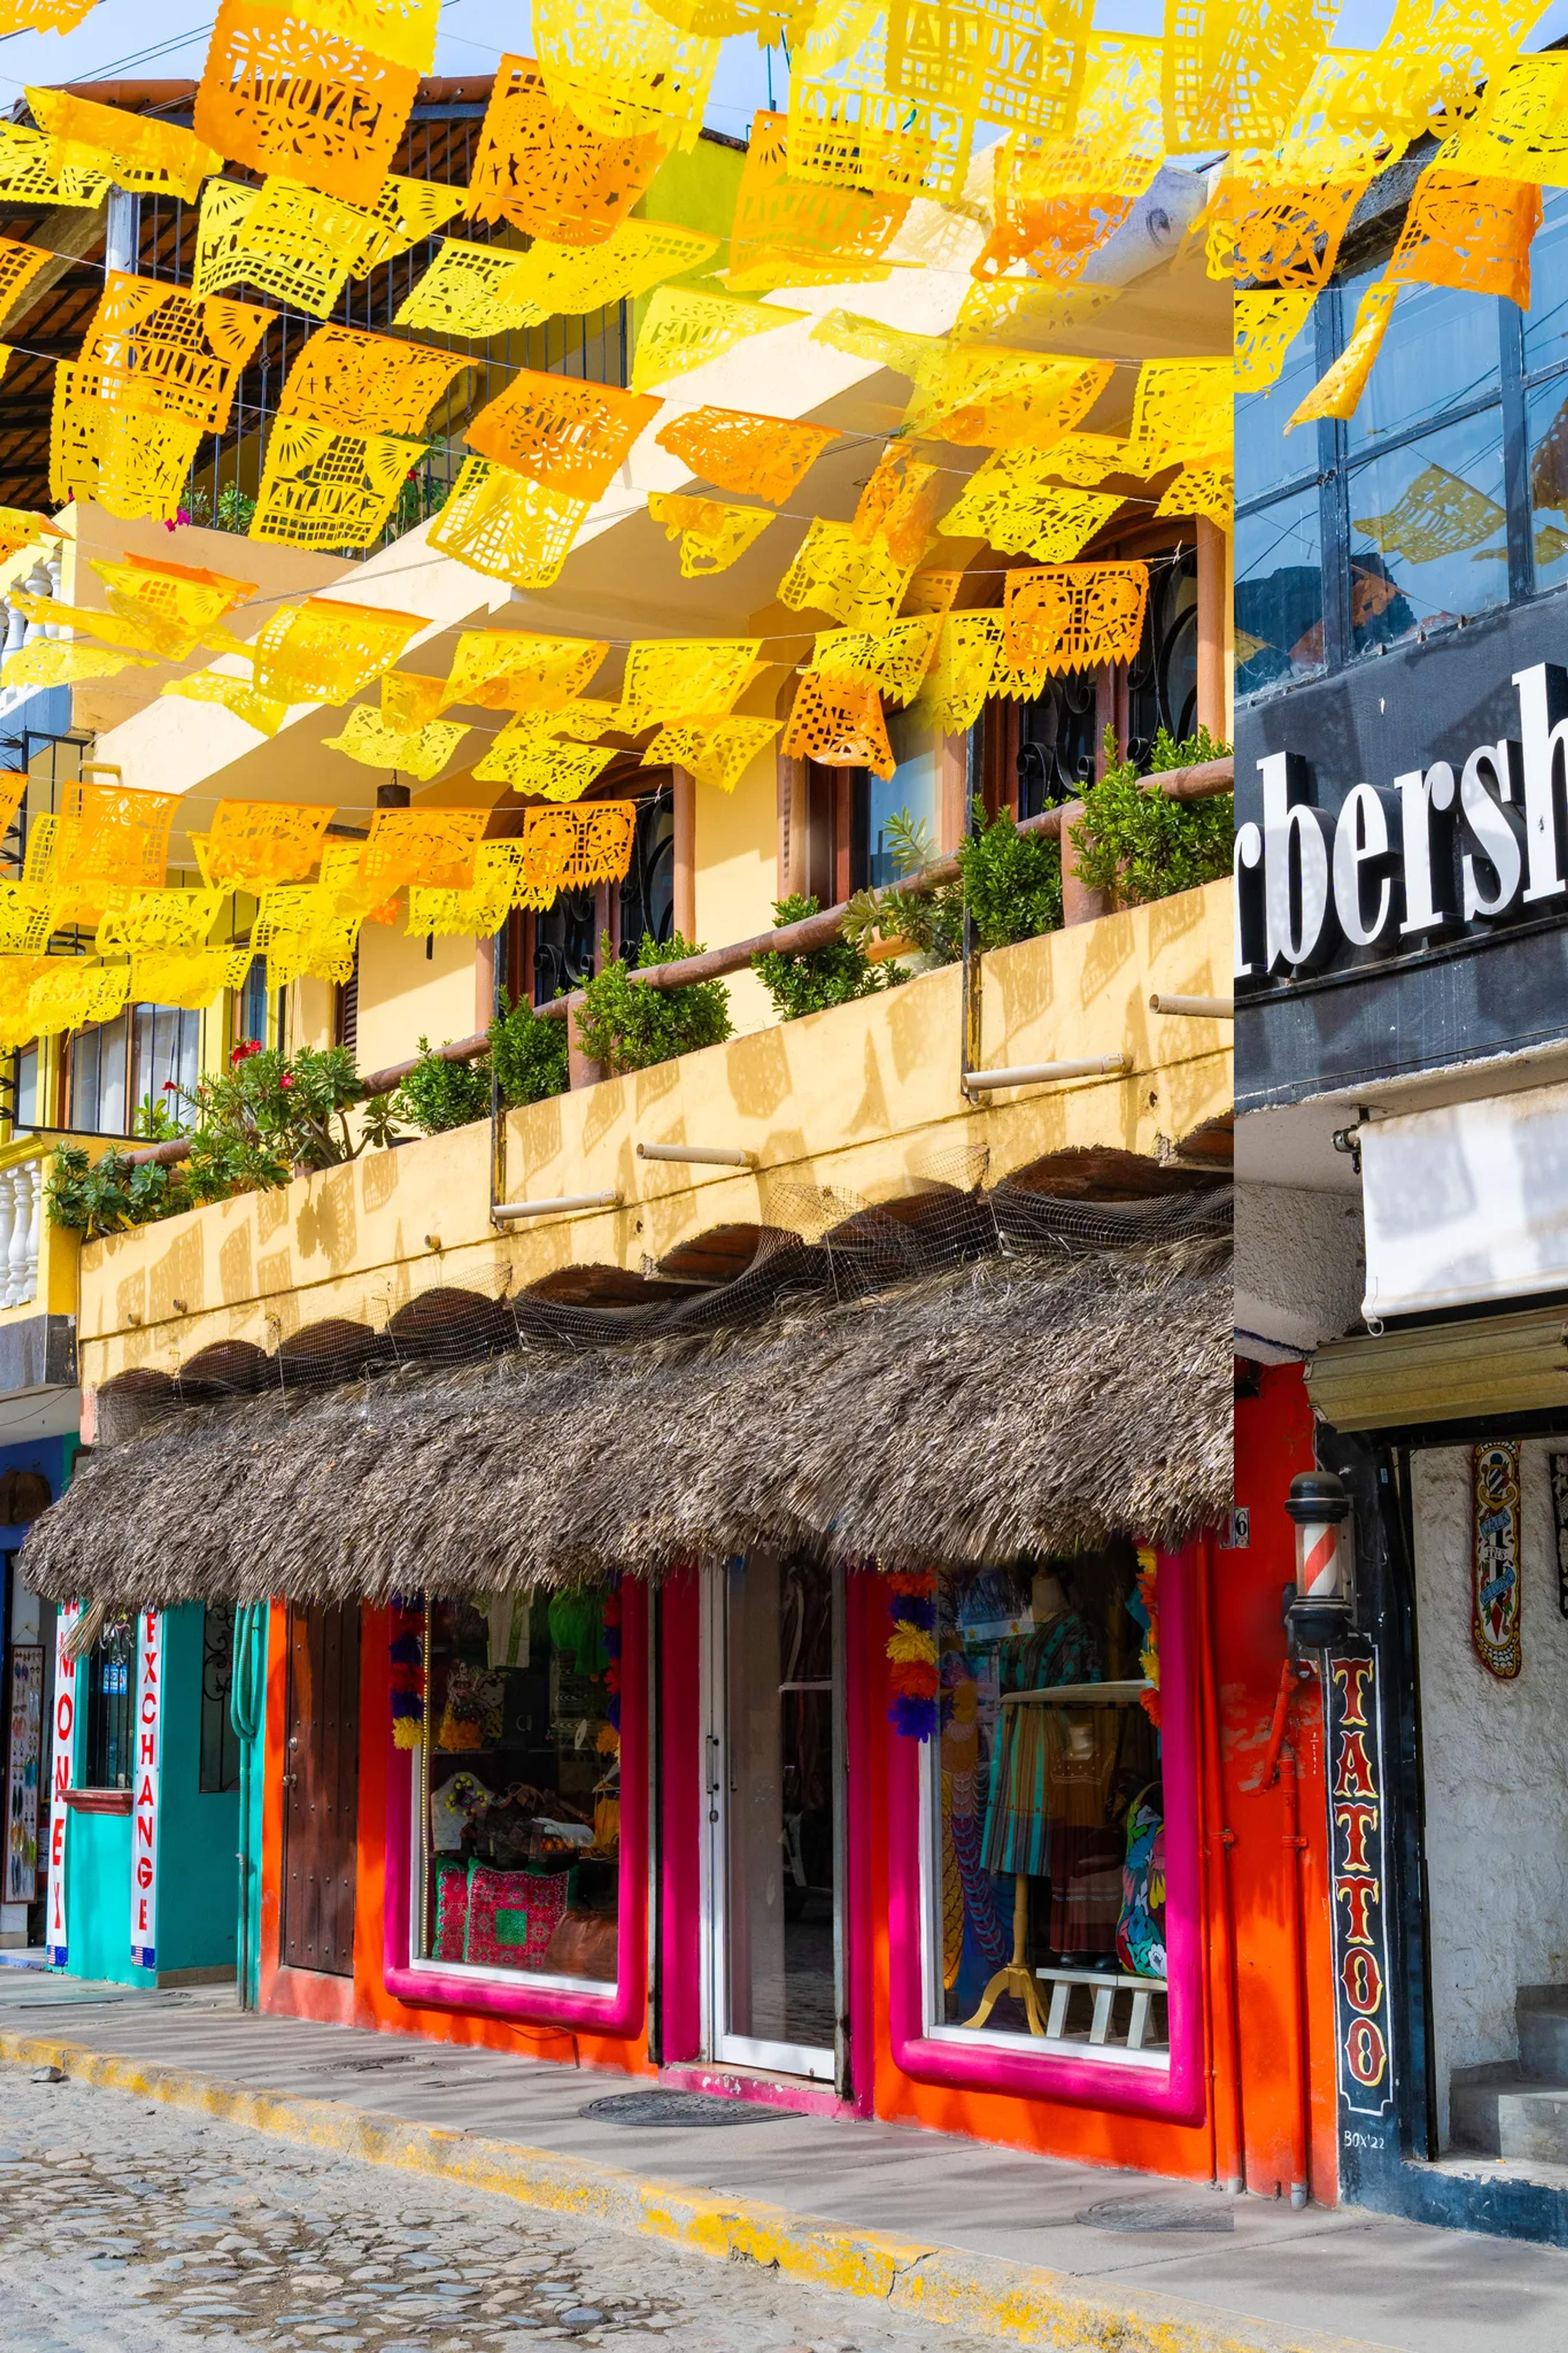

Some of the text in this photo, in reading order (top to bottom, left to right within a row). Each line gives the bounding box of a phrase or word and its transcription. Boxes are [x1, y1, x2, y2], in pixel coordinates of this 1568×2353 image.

[89, 338, 230, 393] SAYULITA
[1236, 1512, 1247, 1536] 6
[53, 1632, 75, 1929] MONEY
[137, 1612, 157, 1930] EXCHANGE
[1330, 1657, 1386, 2087] TATTOO
